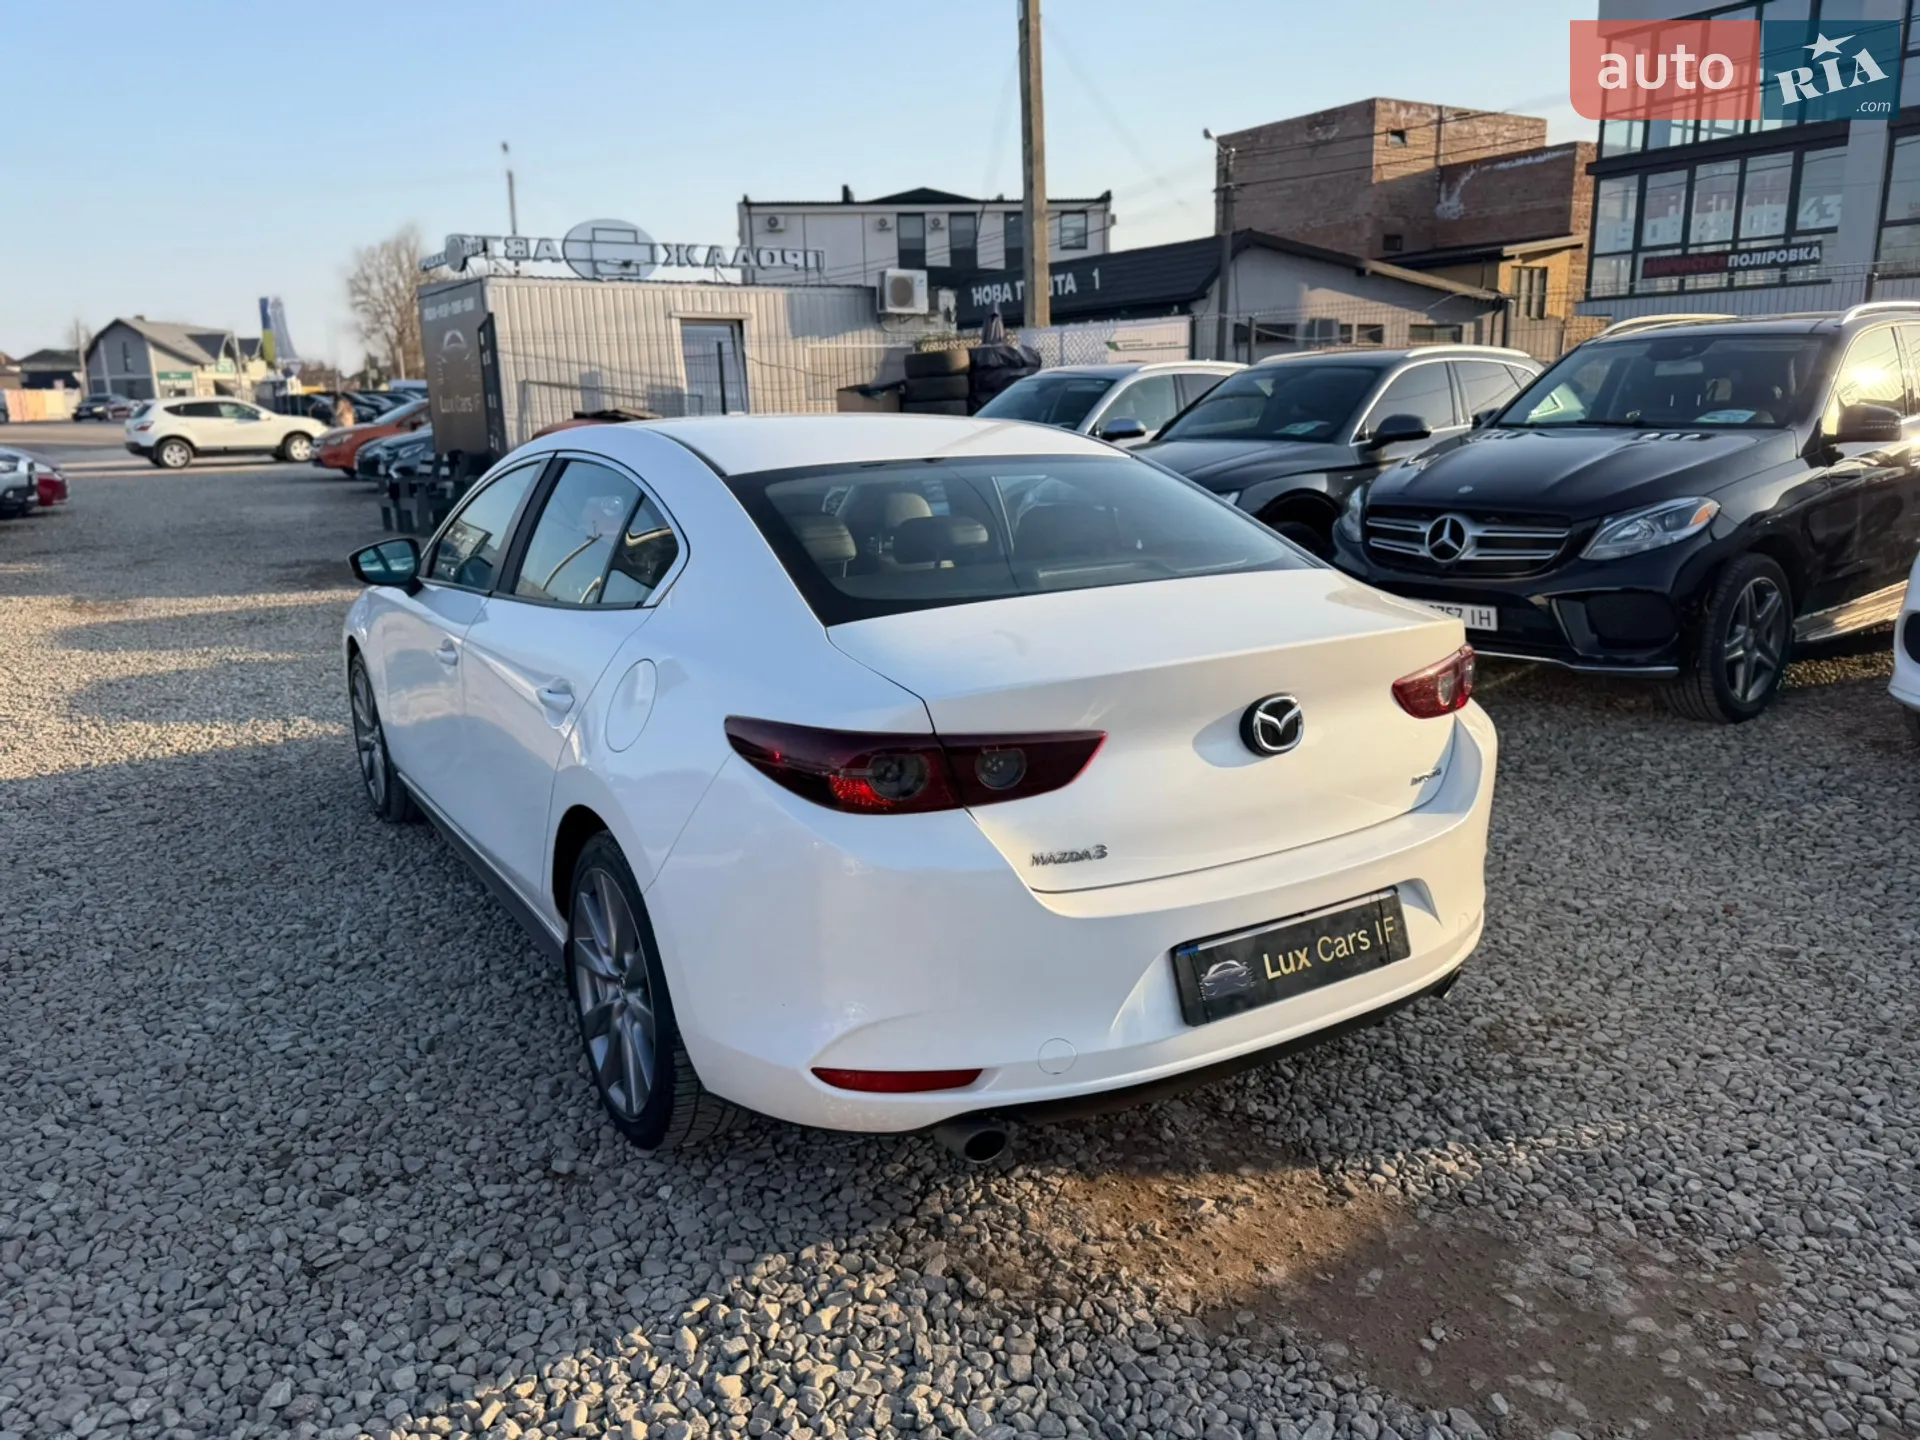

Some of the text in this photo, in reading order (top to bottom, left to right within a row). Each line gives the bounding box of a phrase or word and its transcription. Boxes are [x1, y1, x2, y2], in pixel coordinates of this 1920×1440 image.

[1727, 245, 1821, 268] ПОЛІРОВКА
[971, 282, 1013, 307] НОВА
[1092, 268, 1100, 290] 1
[1262, 946, 1313, 980] Lux
[1317, 927, 1371, 963] Cars
